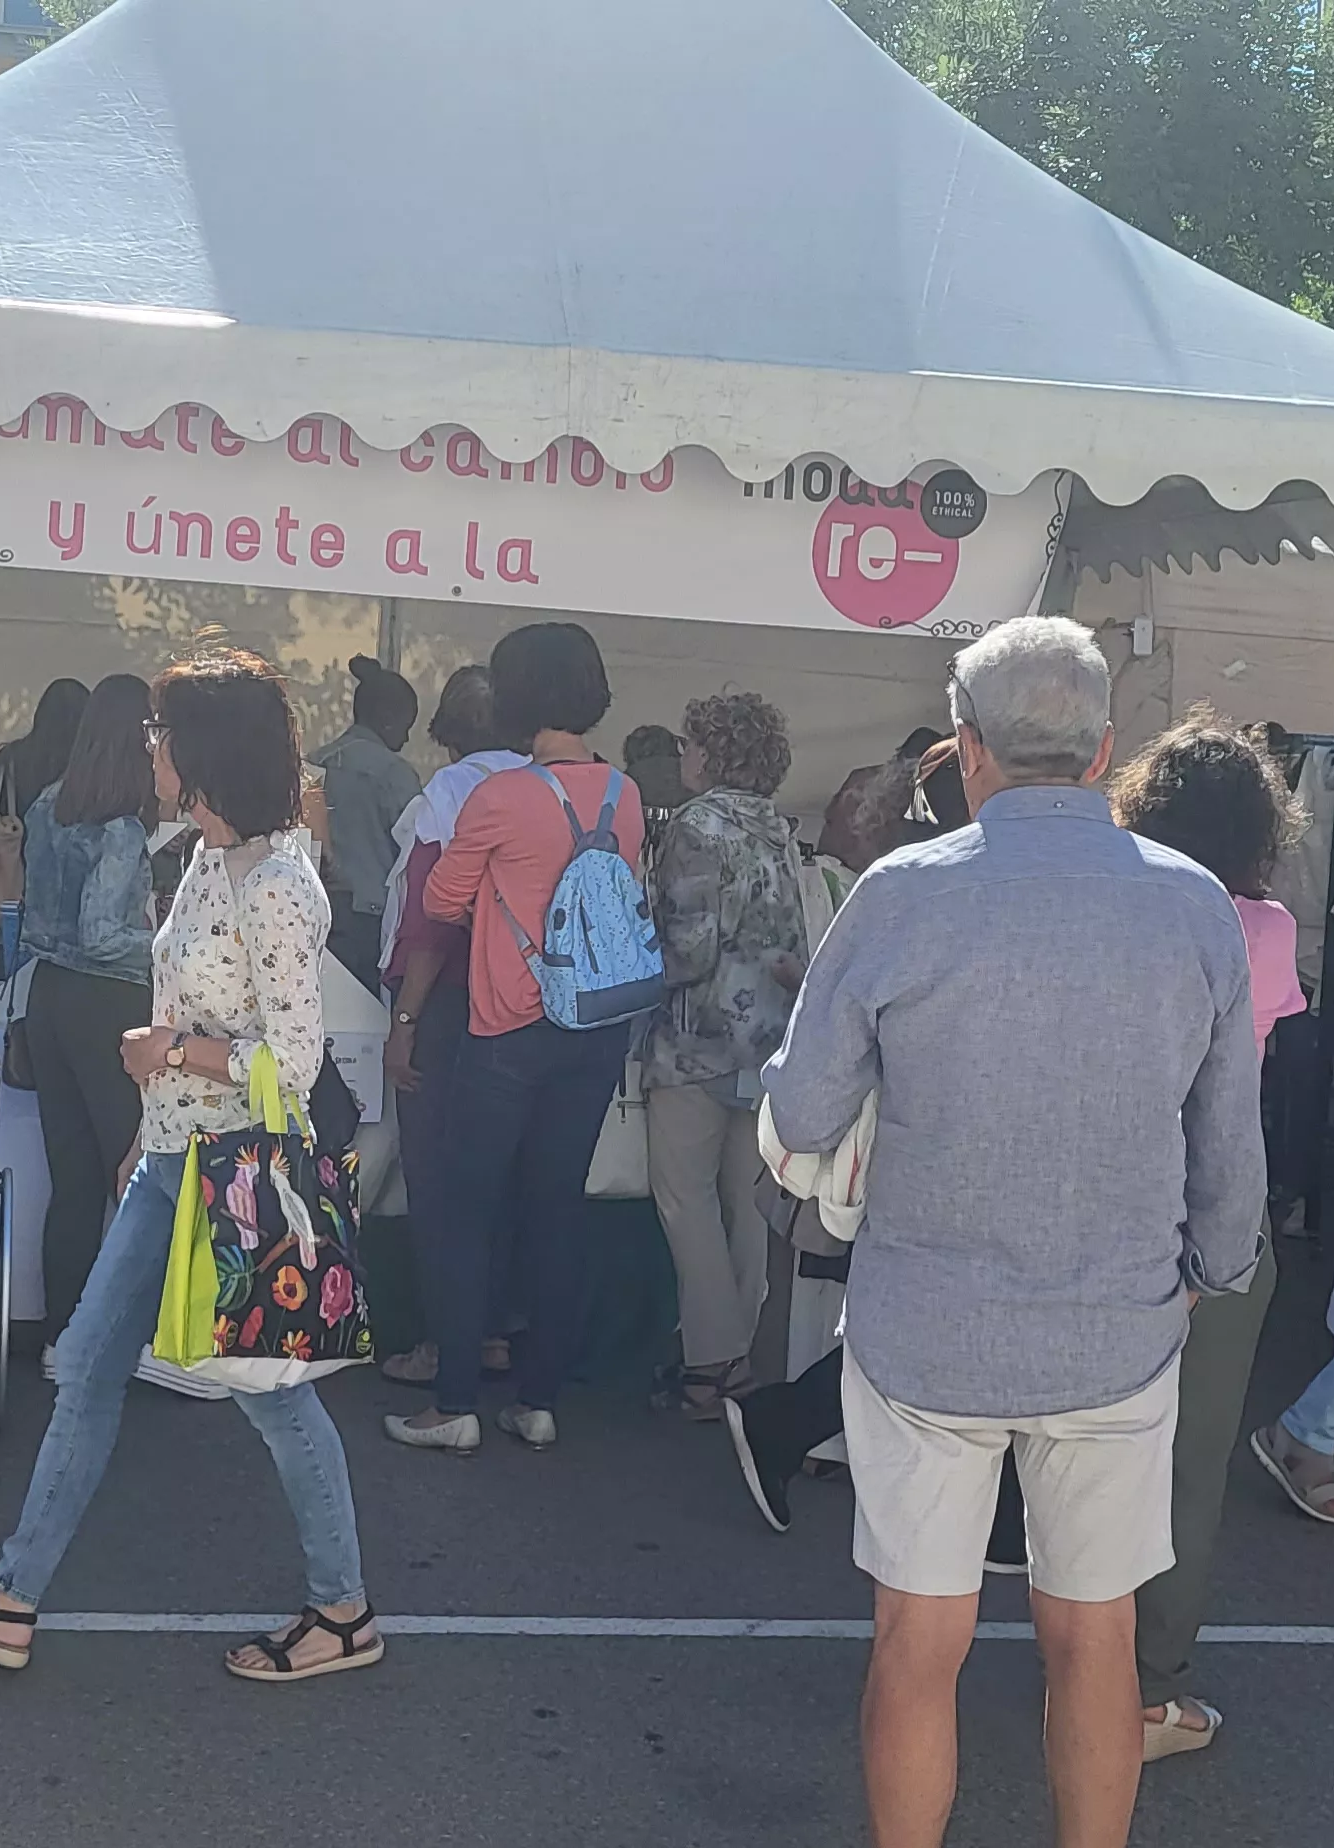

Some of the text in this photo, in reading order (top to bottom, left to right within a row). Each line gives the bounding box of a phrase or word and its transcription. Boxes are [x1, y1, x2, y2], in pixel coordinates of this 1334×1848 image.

[935, 490, 975, 507] 100%
[932, 506, 973, 518] ETHICAL
[48, 495, 540, 585] y únete a la
